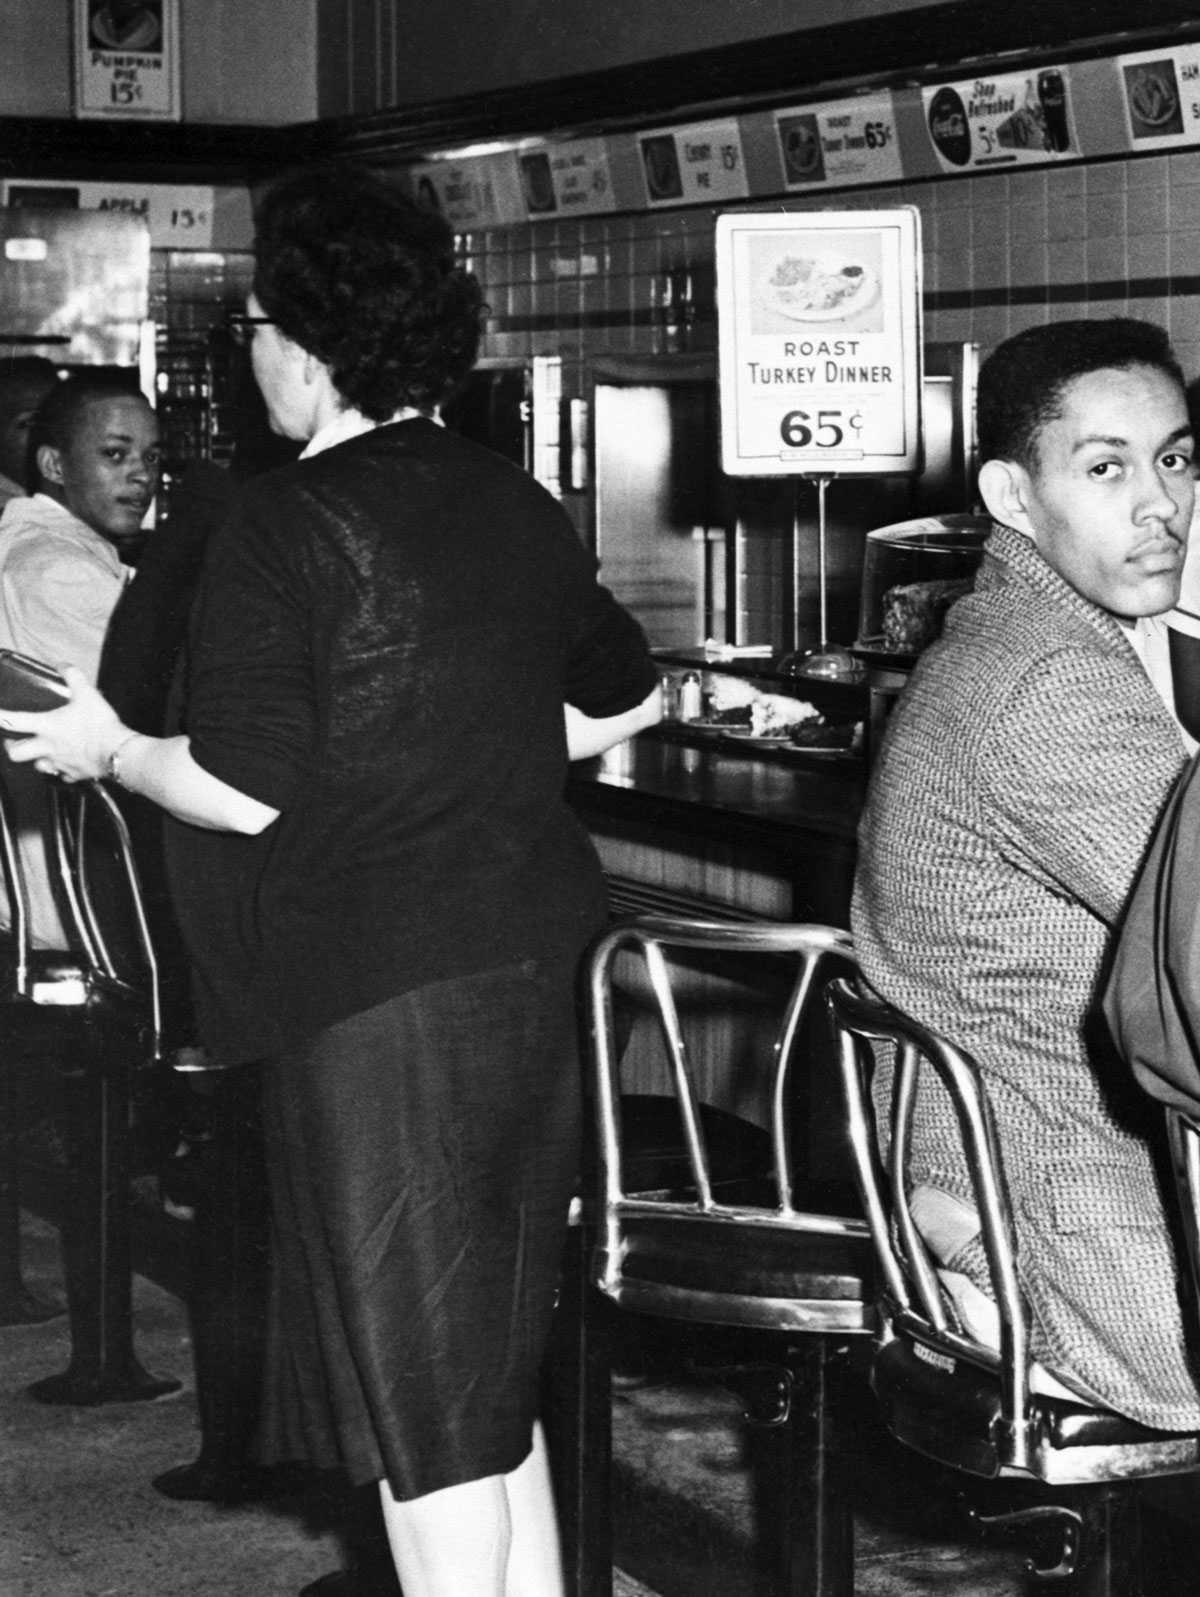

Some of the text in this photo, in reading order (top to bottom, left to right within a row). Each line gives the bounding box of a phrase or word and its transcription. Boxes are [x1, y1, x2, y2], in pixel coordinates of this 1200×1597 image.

[91, 51, 162, 71] PUMPKIN
[114, 68, 137, 81] PIE
[864, 121, 892, 149] 65¢
[99, 197, 149, 215] APPLE
[784, 340, 860, 357] ROAST
[747, 360, 893, 384] TURKEY DINNER
[780, 409, 863, 448] 65¢
